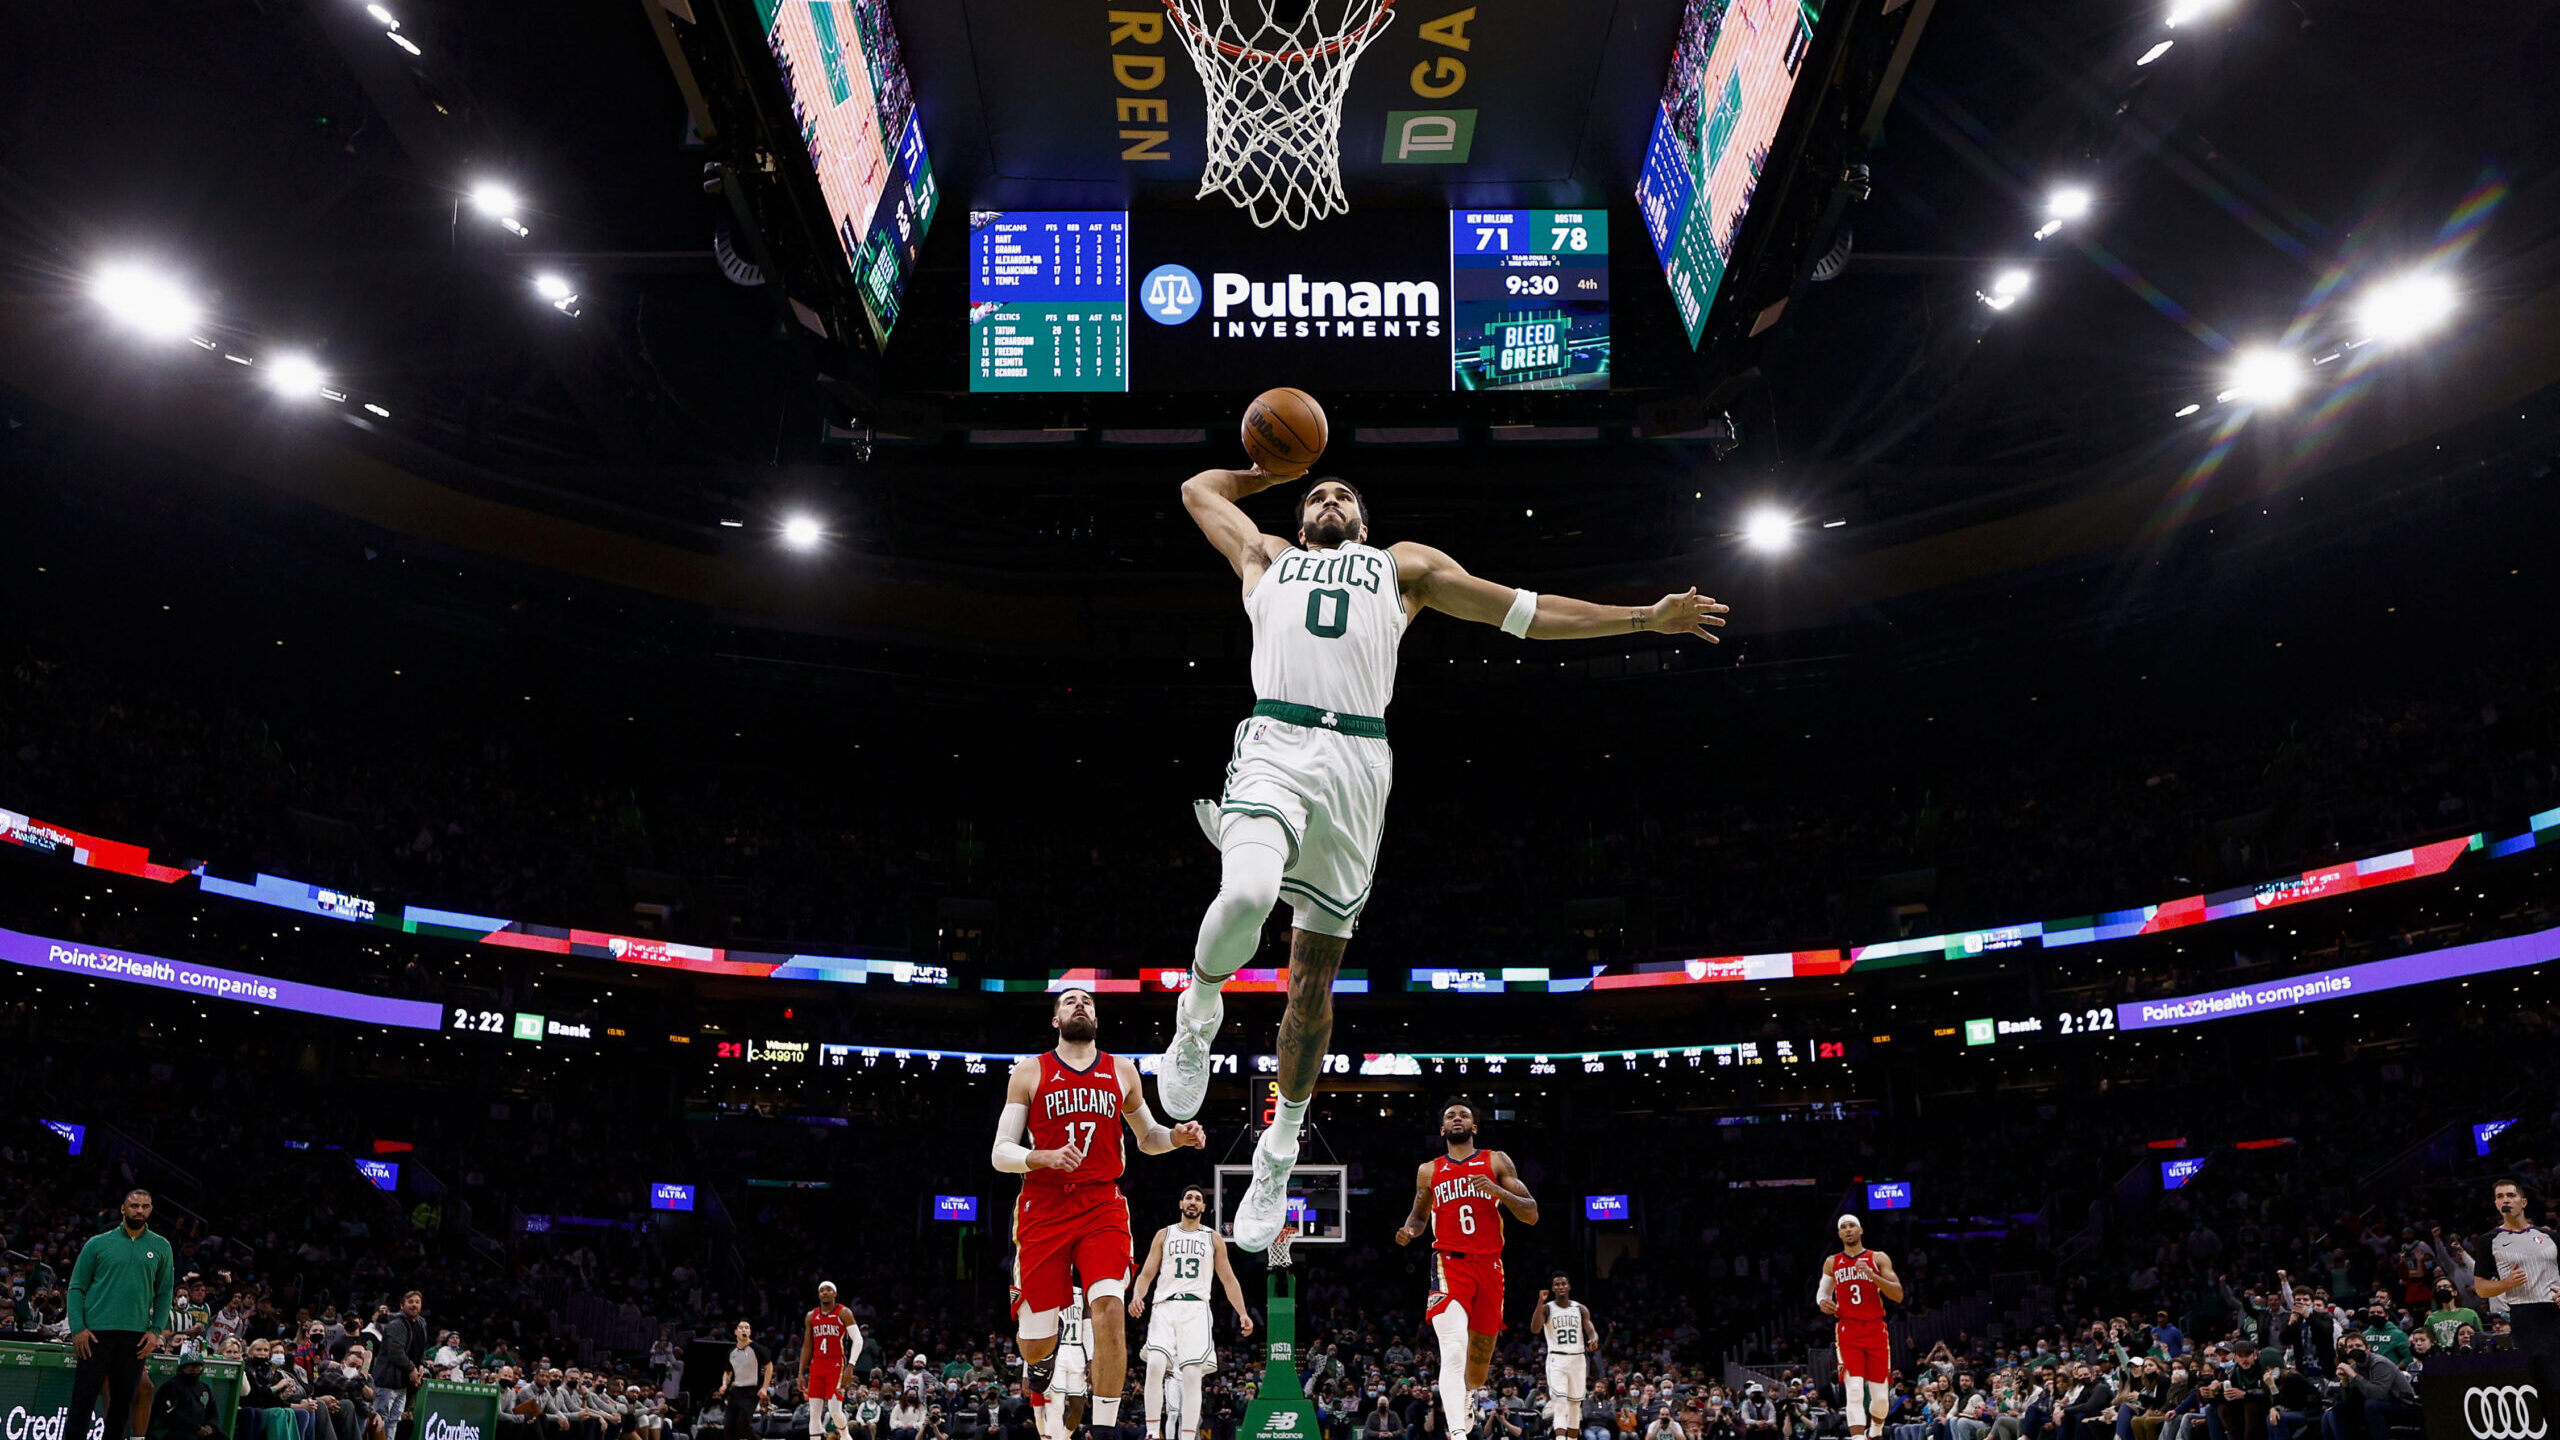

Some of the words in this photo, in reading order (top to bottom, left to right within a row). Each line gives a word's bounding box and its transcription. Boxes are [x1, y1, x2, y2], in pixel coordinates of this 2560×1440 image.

[1467, 214, 1482, 223] NEW
[1483, 214, 1513, 223] ORLEANS
[1555, 214, 1583, 223] BOSTON
[1476, 227, 1509, 251] 71
[1551, 227, 1588, 251] 78
[982, 266, 989, 274] 17
[1053, 266, 1061, 274] 17
[1505, 275, 1559, 295] 9:30
[1577, 279, 1598, 290] 4th
[1213, 273, 1440, 317] Putnam
[1213, 321, 1440, 338] INVESTMENTS
[1505, 324, 1555, 348] BLEED
[1501, 344, 1559, 371] GREEN
[1279, 554, 1382, 594] CELTICS
[1305, 588, 1350, 639] 0
[337, 894, 375, 912] TUFTS
[49, 945, 175, 981] Point32Health
[179, 970, 277, 1000] companies
[912, 966, 948, 978] TUFTS
[2142, 990, 2253, 1024] Point32Health
[2256, 972, 2351, 1013] companies
[454, 1008, 504, 1033] 2:22
[518, 1017, 541, 1035] TD
[548, 1020, 591, 1038] Bank
[1967, 1023, 1993, 1041] TD
[1997, 1017, 2042, 1034] Bank
[2058, 1008, 2115, 1034] 2:22
[717, 1042, 742, 1058] 21
[751, 1049, 804, 1062] C-349910
[861, 1048, 880, 1057] AST
[1683, 1047, 1703, 1056] AST
[1820, 1042, 1844, 1058] 21
[832, 1056, 844, 1066] 31
[864, 1058, 876, 1067] 17
[899, 1059, 905, 1069] 7
[931, 1061, 937, 1070] 7
[966, 1063, 987, 1074] 7/25
[1210, 1054, 1237, 1074] 71
[1322, 1054, 1350, 1074] 78
[1435, 1065, 1442, 1073] 4
[1460, 1065, 1467, 1073] 0
[1488, 1065, 1502, 1073] 44
[1625, 1061, 1636, 1070] 11
[1658, 1059, 1666, 1068] 4
[1689, 1057, 1701, 1067] 17
[1718, 1056, 1731, 1065] 39
[1044, 1087, 1117, 1120] PELICANS
[1064, 1121, 1096, 1157] 17
[657, 1189, 687, 1200] ULTRA
[1874, 1189, 1903, 1199] ULTRA
[941, 1201, 970, 1211] ULTRA
[1591, 1201, 1621, 1210] ULTRA
[1459, 1204, 1476, 1235] 6
[1168, 1239, 1206, 1257] CELTICS
[1174, 1257, 1200, 1278] 13
[1850, 1284, 1862, 1305] 3
[1552, 1315, 1579, 1329] CELTICS
[819, 1338, 827, 1354] 4
[1557, 1329, 1577, 1345] 26
[1270, 1343, 1291, 1353] VISTA
[1270, 1352, 1291, 1361] PRINT
[1273, 1431, 1304, 1439] balance
